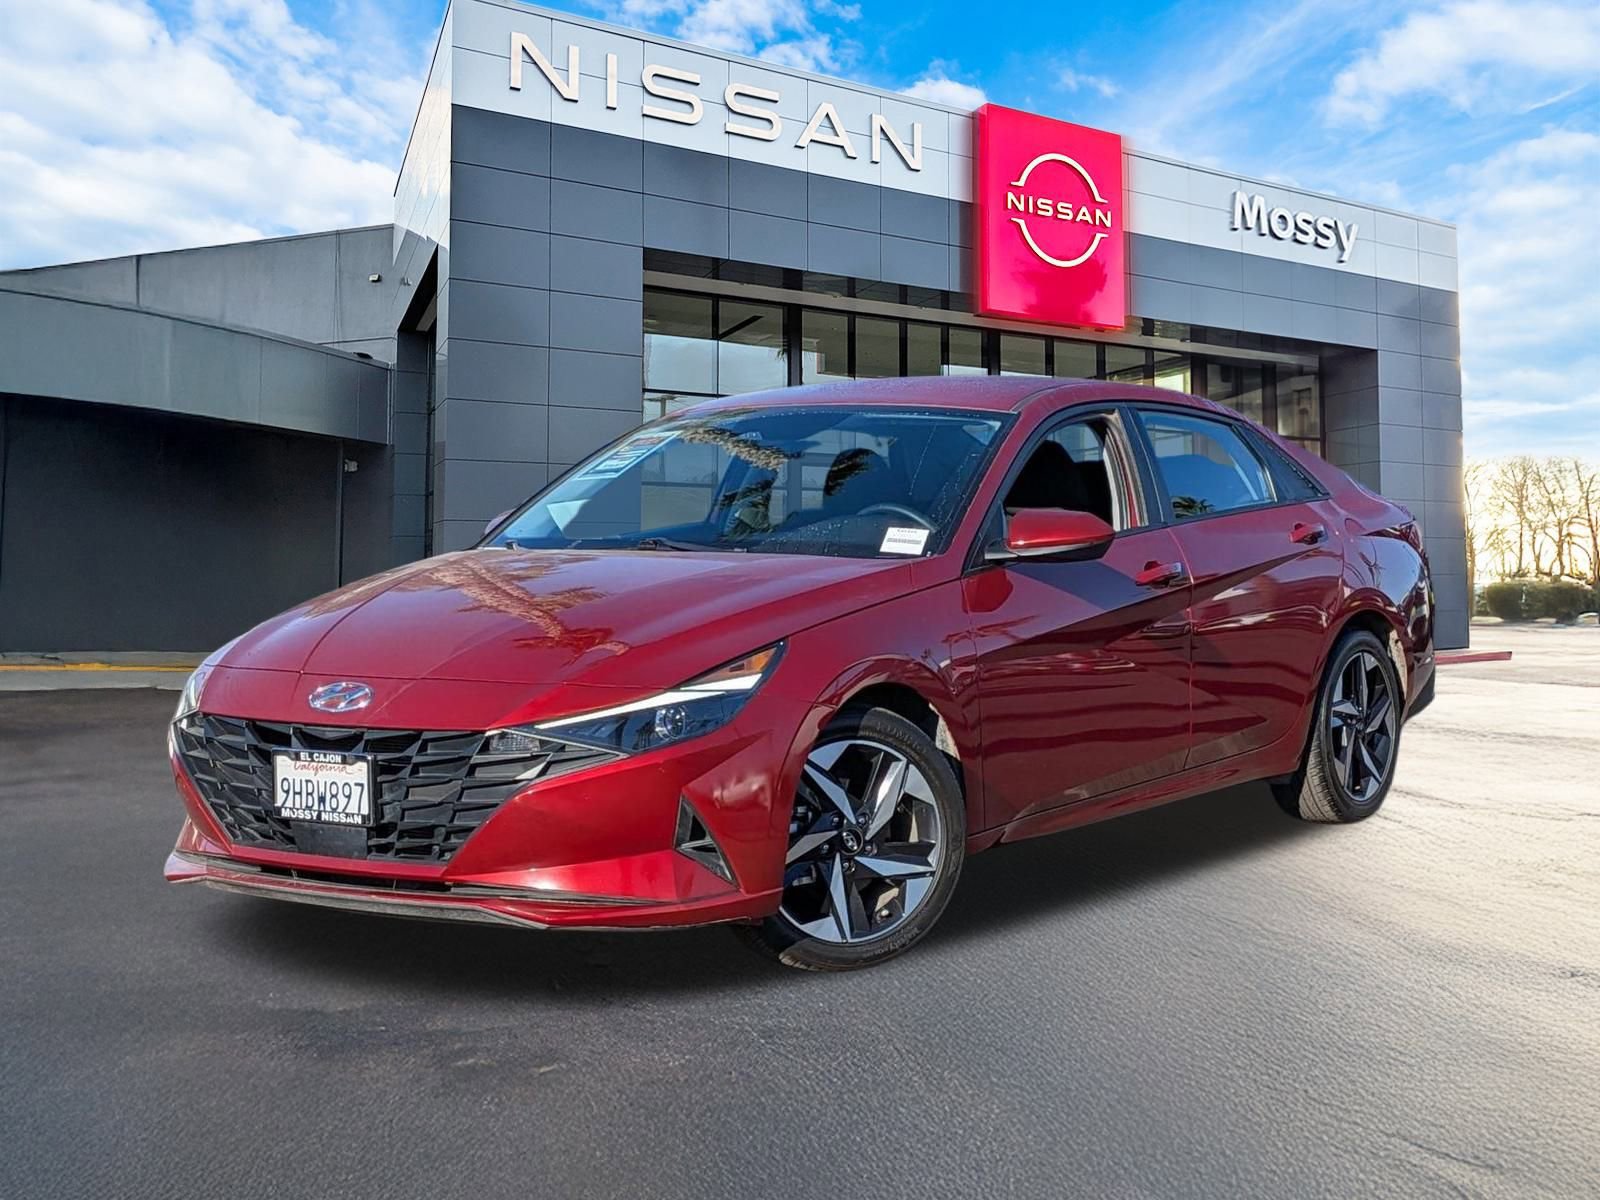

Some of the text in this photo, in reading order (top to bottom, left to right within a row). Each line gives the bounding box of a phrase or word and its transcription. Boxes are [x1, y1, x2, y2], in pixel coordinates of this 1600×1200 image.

[509, 31, 923, 172] NISSAN
[1006, 190, 1112, 229] NISSAN
[1231, 190, 1360, 263] Mossy
[294, 762, 352, 776] California
[300, 752, 342, 763] EL CAJON
[280, 777, 365, 813] 9HBW897
[281, 807, 362, 825] MOSSY NISSAN
